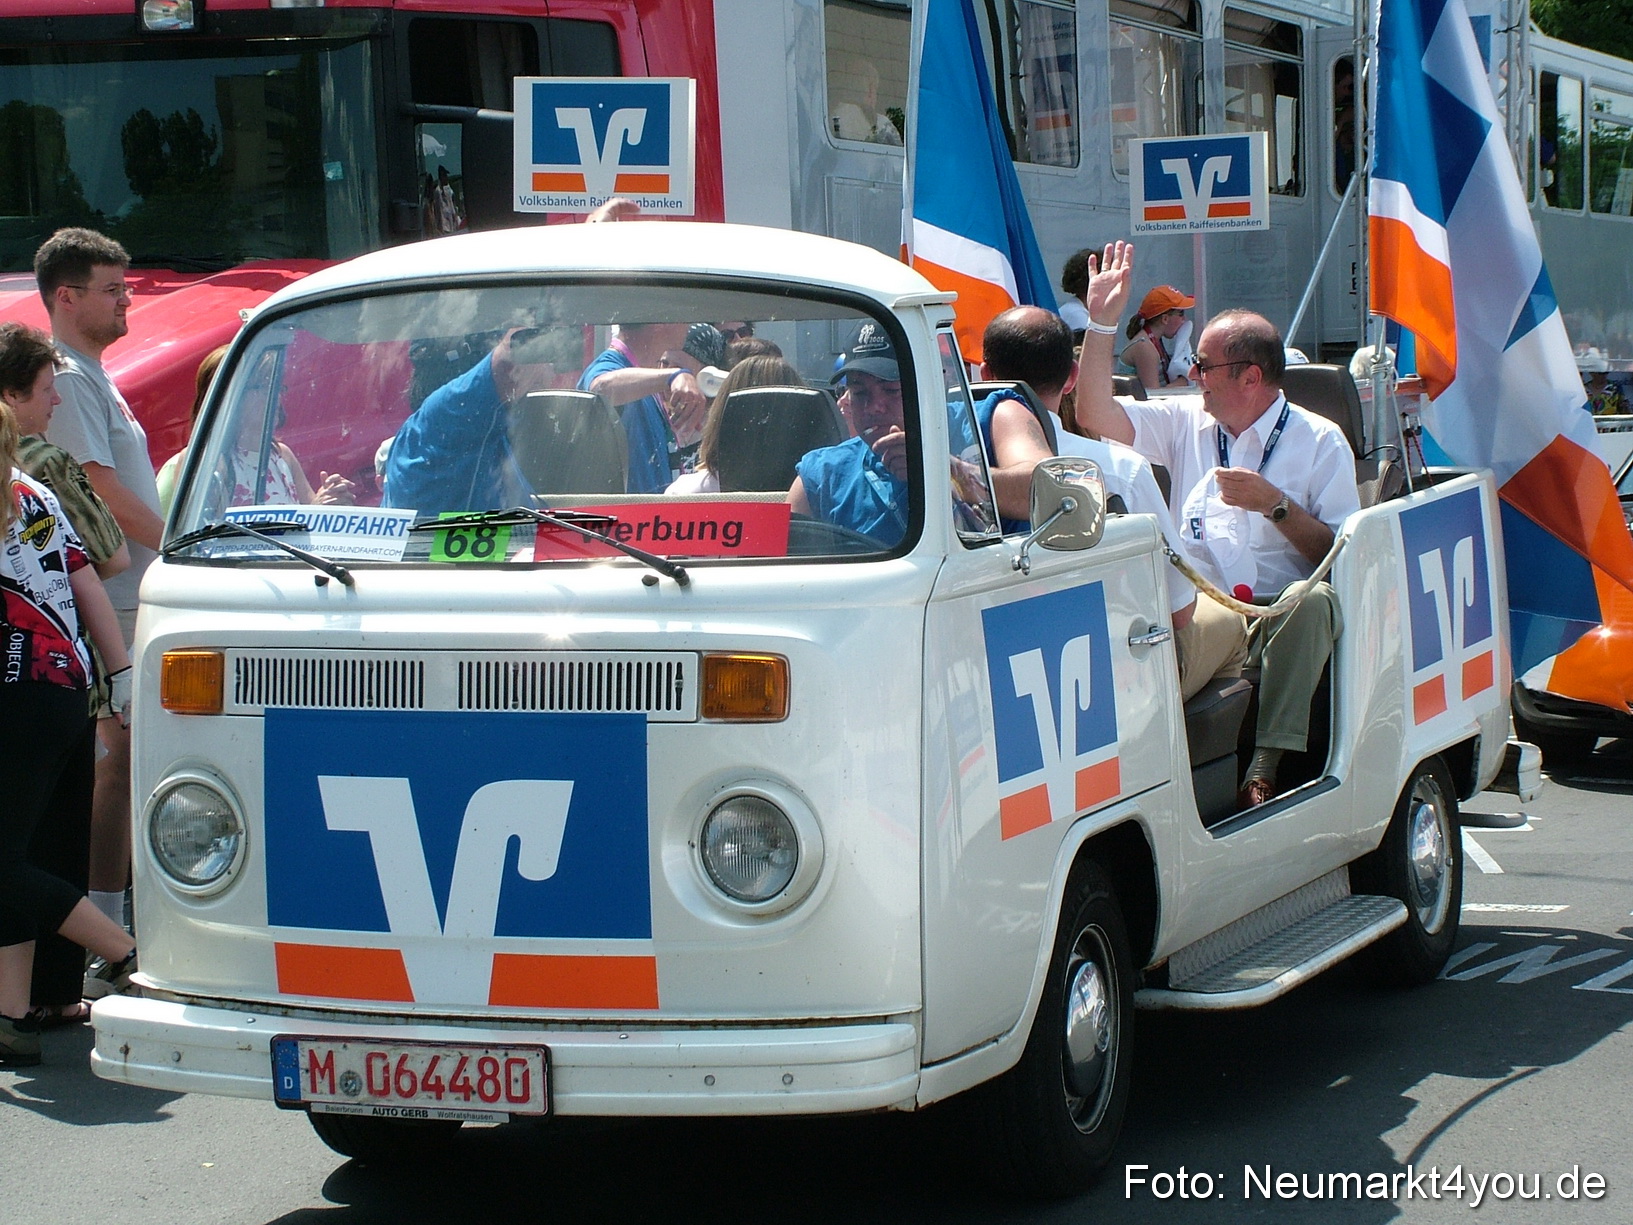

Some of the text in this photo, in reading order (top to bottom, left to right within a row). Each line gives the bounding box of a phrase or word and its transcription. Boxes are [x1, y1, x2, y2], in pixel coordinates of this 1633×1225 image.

[519, 195, 683, 209] Volksbanken Raifnbanken
[1135, 219, 1262, 232] Volksbanken Raiffeisenbanken
[293, 513, 412, 537] RUNDFAHRT
[583, 515, 744, 547] Werbung
[443, 525, 498, 558] 68
[5, 633, 25, 683] OBJECTS
[284, 1077, 293, 1089] D
[308, 1049, 530, 1104] M 064480
[325, 1105, 494, 1121] Baierbrunn AUTO GERB Wolfratshausen
